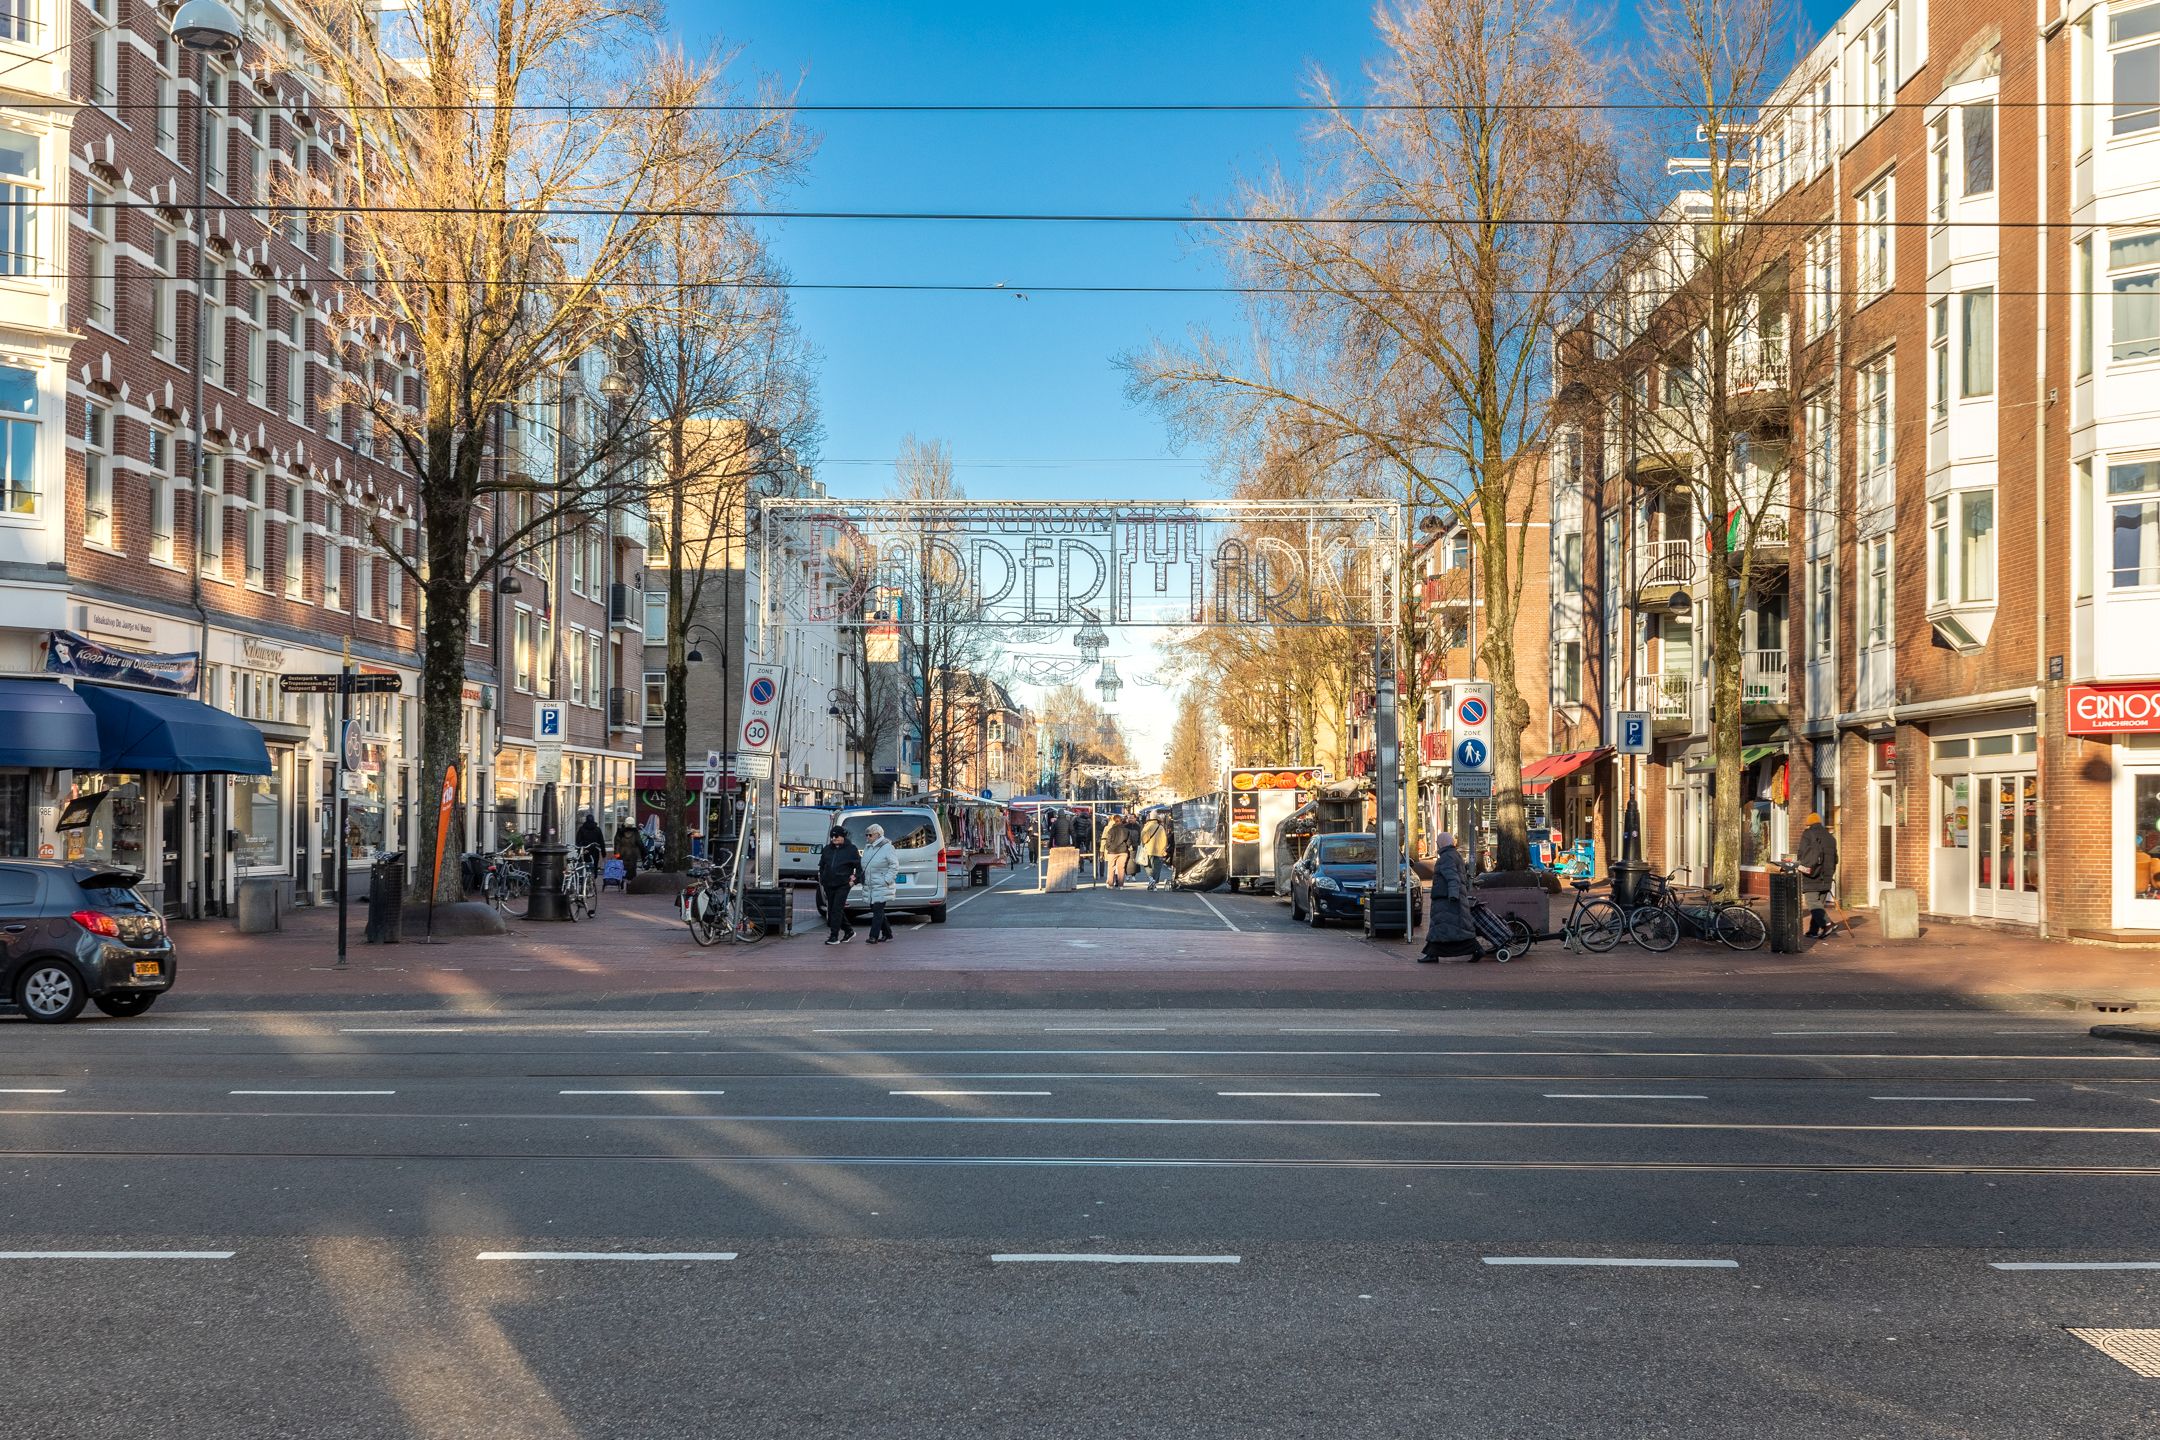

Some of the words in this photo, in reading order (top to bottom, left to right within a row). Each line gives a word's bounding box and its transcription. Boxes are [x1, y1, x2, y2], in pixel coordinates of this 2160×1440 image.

[76, 648, 104, 664] Koop
[103, 654, 122, 667] hier
[120, 658, 133, 668] uw
[545, 711, 556, 725] P
[748, 727, 766, 739] 30
[1629, 722, 1640, 736] P
[39, 807, 52, 816] 98E
[40, 845, 54, 855] ria
